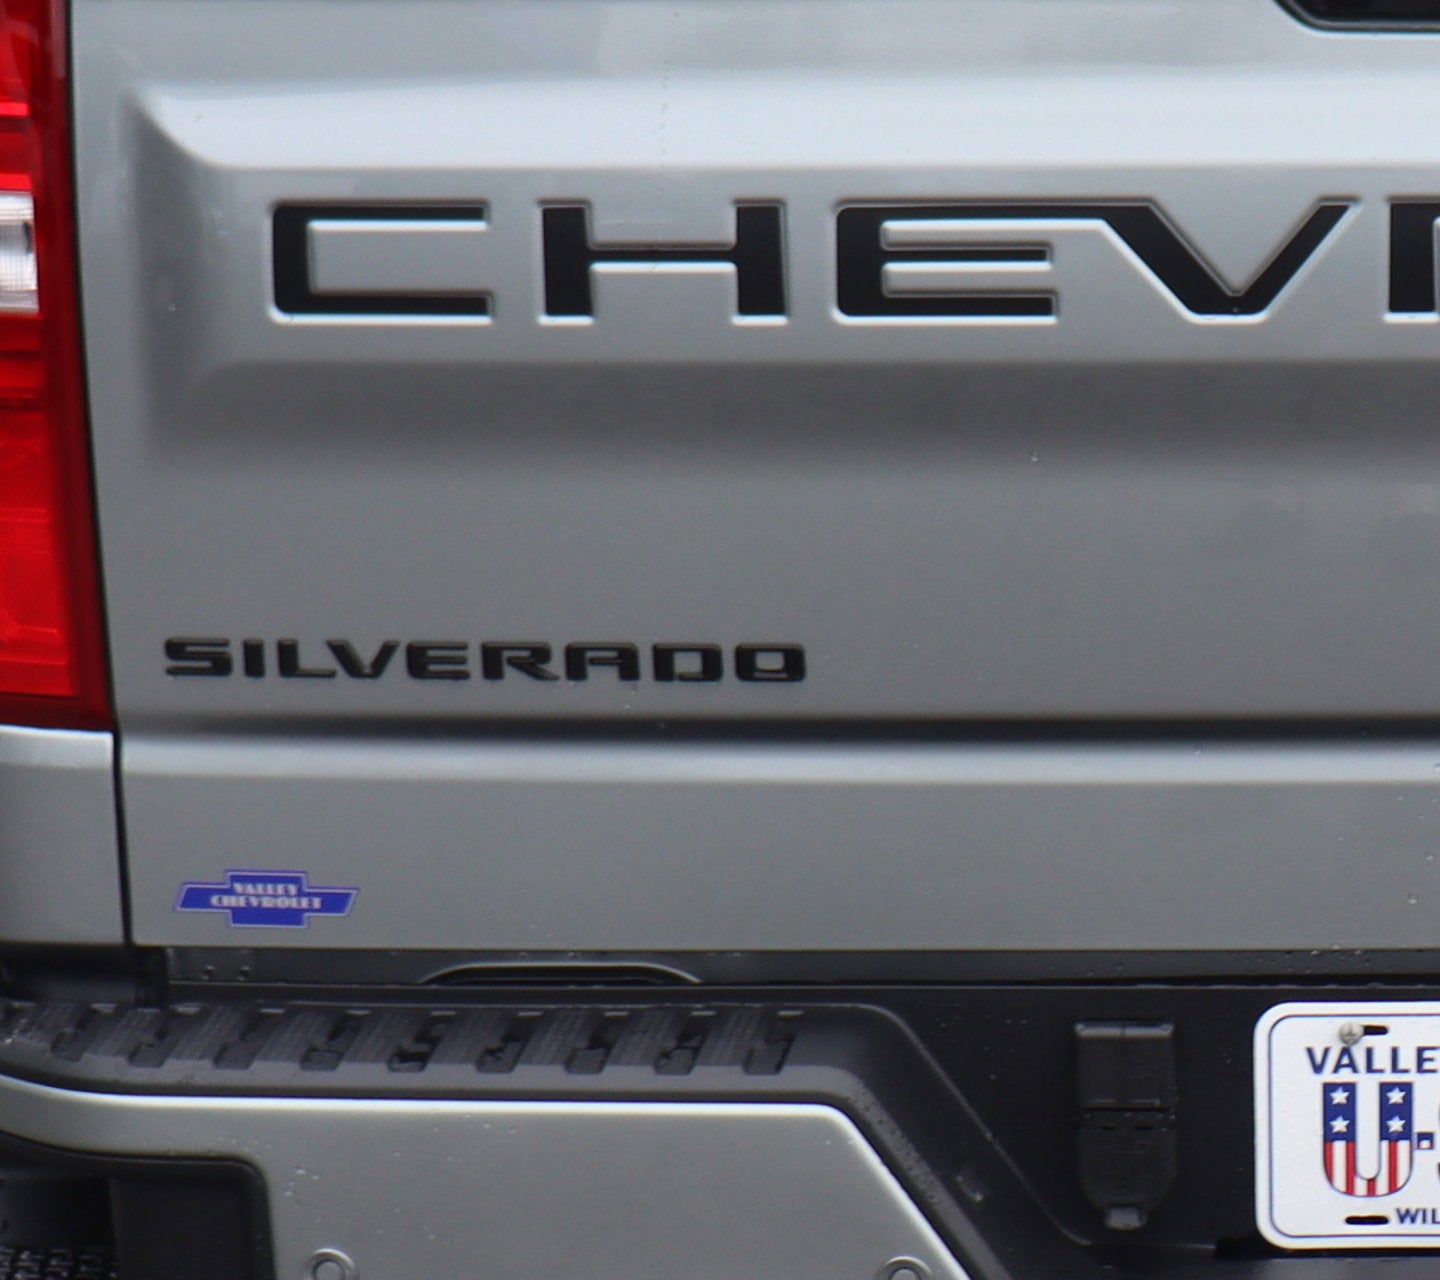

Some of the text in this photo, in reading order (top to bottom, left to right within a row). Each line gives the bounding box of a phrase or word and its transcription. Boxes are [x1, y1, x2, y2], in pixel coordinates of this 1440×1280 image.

[163, 635, 808, 685] SILVERADO
[232, 882, 300, 896] VALLEY
[210, 894, 323, 910] CHEVROLET
